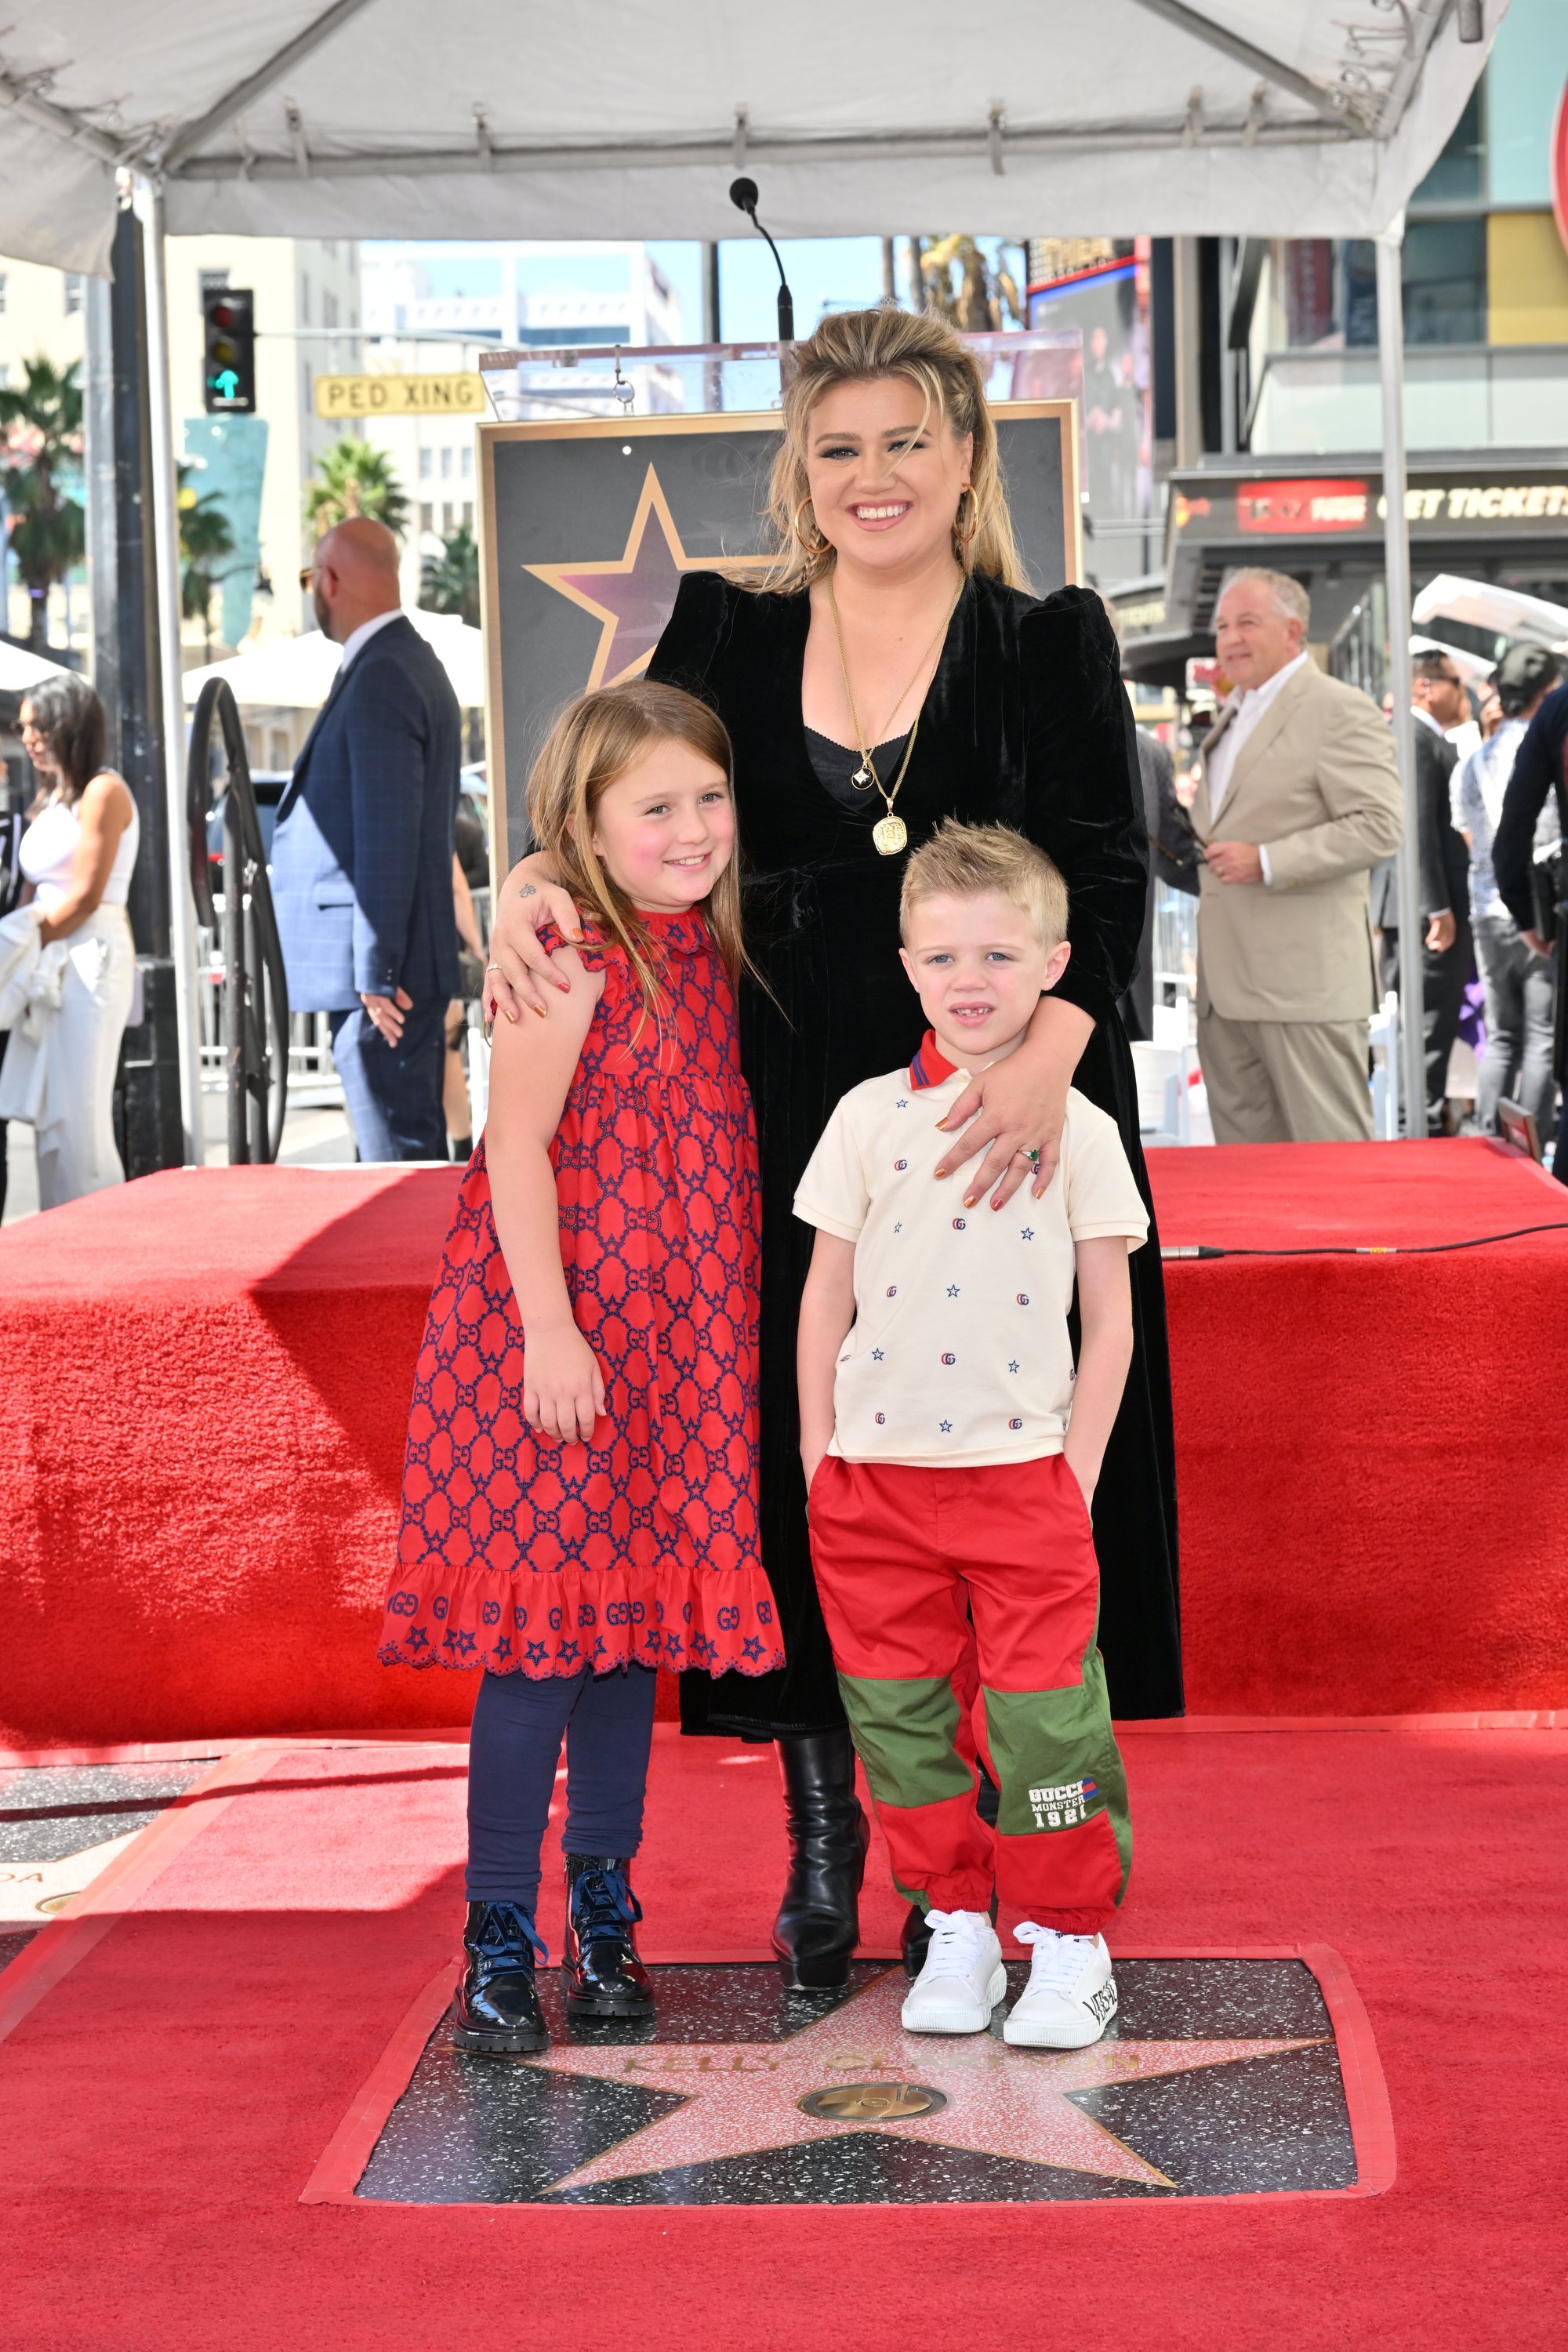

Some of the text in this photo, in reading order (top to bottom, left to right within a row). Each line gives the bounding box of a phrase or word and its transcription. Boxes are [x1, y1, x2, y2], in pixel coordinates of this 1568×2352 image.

[328, 380, 473, 408] PED XING
[1029, 1780, 1083, 1802] GUCCI
[1031, 1795, 1085, 1813] MONSTER
[1034, 1804, 1087, 1828] 1921
[623, 2054, 1140, 2072] KELLY CLARKSON
